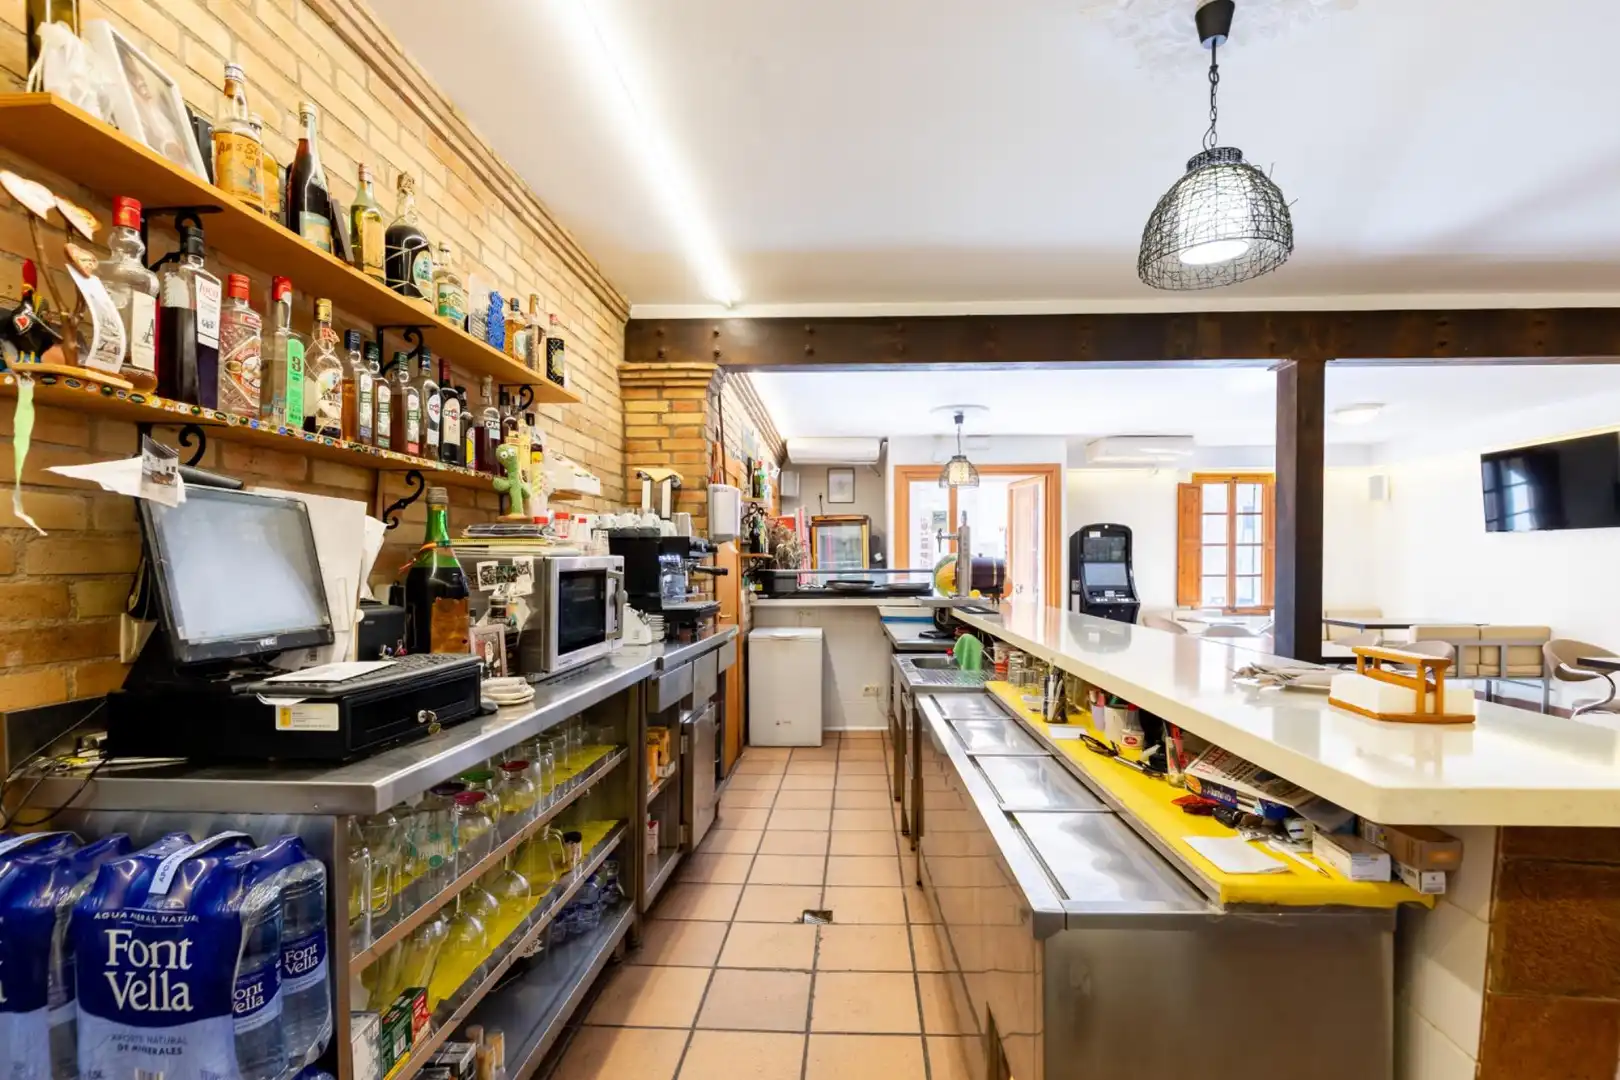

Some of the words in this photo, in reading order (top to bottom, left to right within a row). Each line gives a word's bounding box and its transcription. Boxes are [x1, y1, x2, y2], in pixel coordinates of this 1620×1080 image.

[104, 929, 193, 970] Font
[285, 943, 318, 963] Font
[284, 956, 319, 975] Vella
[103, 970, 194, 1012] Vella
[234, 981, 264, 1000] ont
